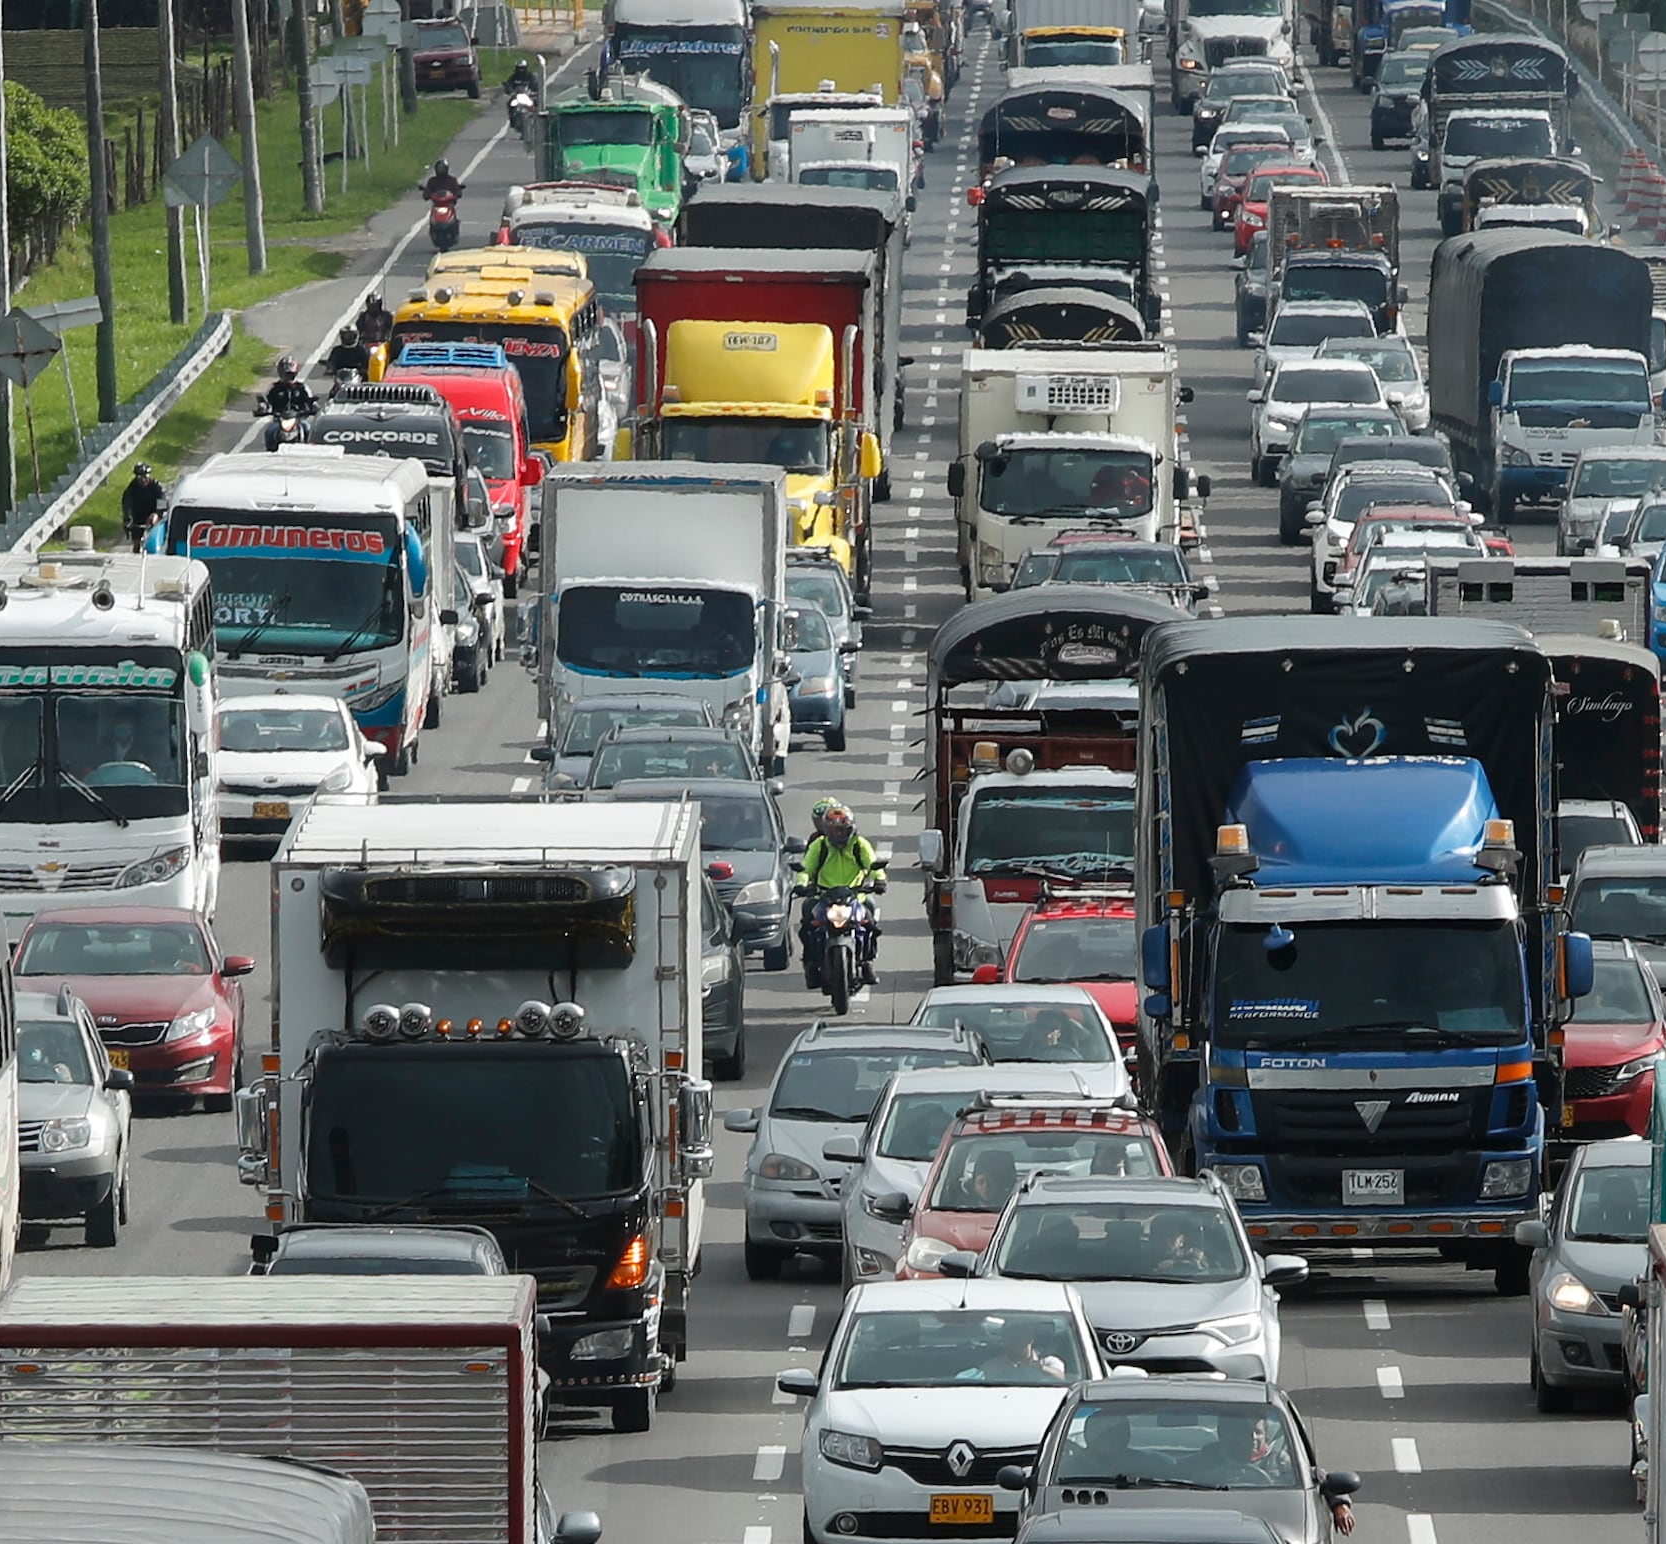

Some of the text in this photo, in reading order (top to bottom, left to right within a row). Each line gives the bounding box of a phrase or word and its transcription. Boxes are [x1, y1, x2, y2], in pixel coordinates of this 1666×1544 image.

[548, 235, 646, 253] CARMEN
[505, 337, 560, 358] TENZA
[322, 430, 439, 446] CONCORDE
[188, 519, 385, 555] Comuneros
[1566, 690, 1633, 722] Santiago
[1260, 1057, 1326, 1069] FOTON
[932, 1498, 991, 1516] EBV 931
